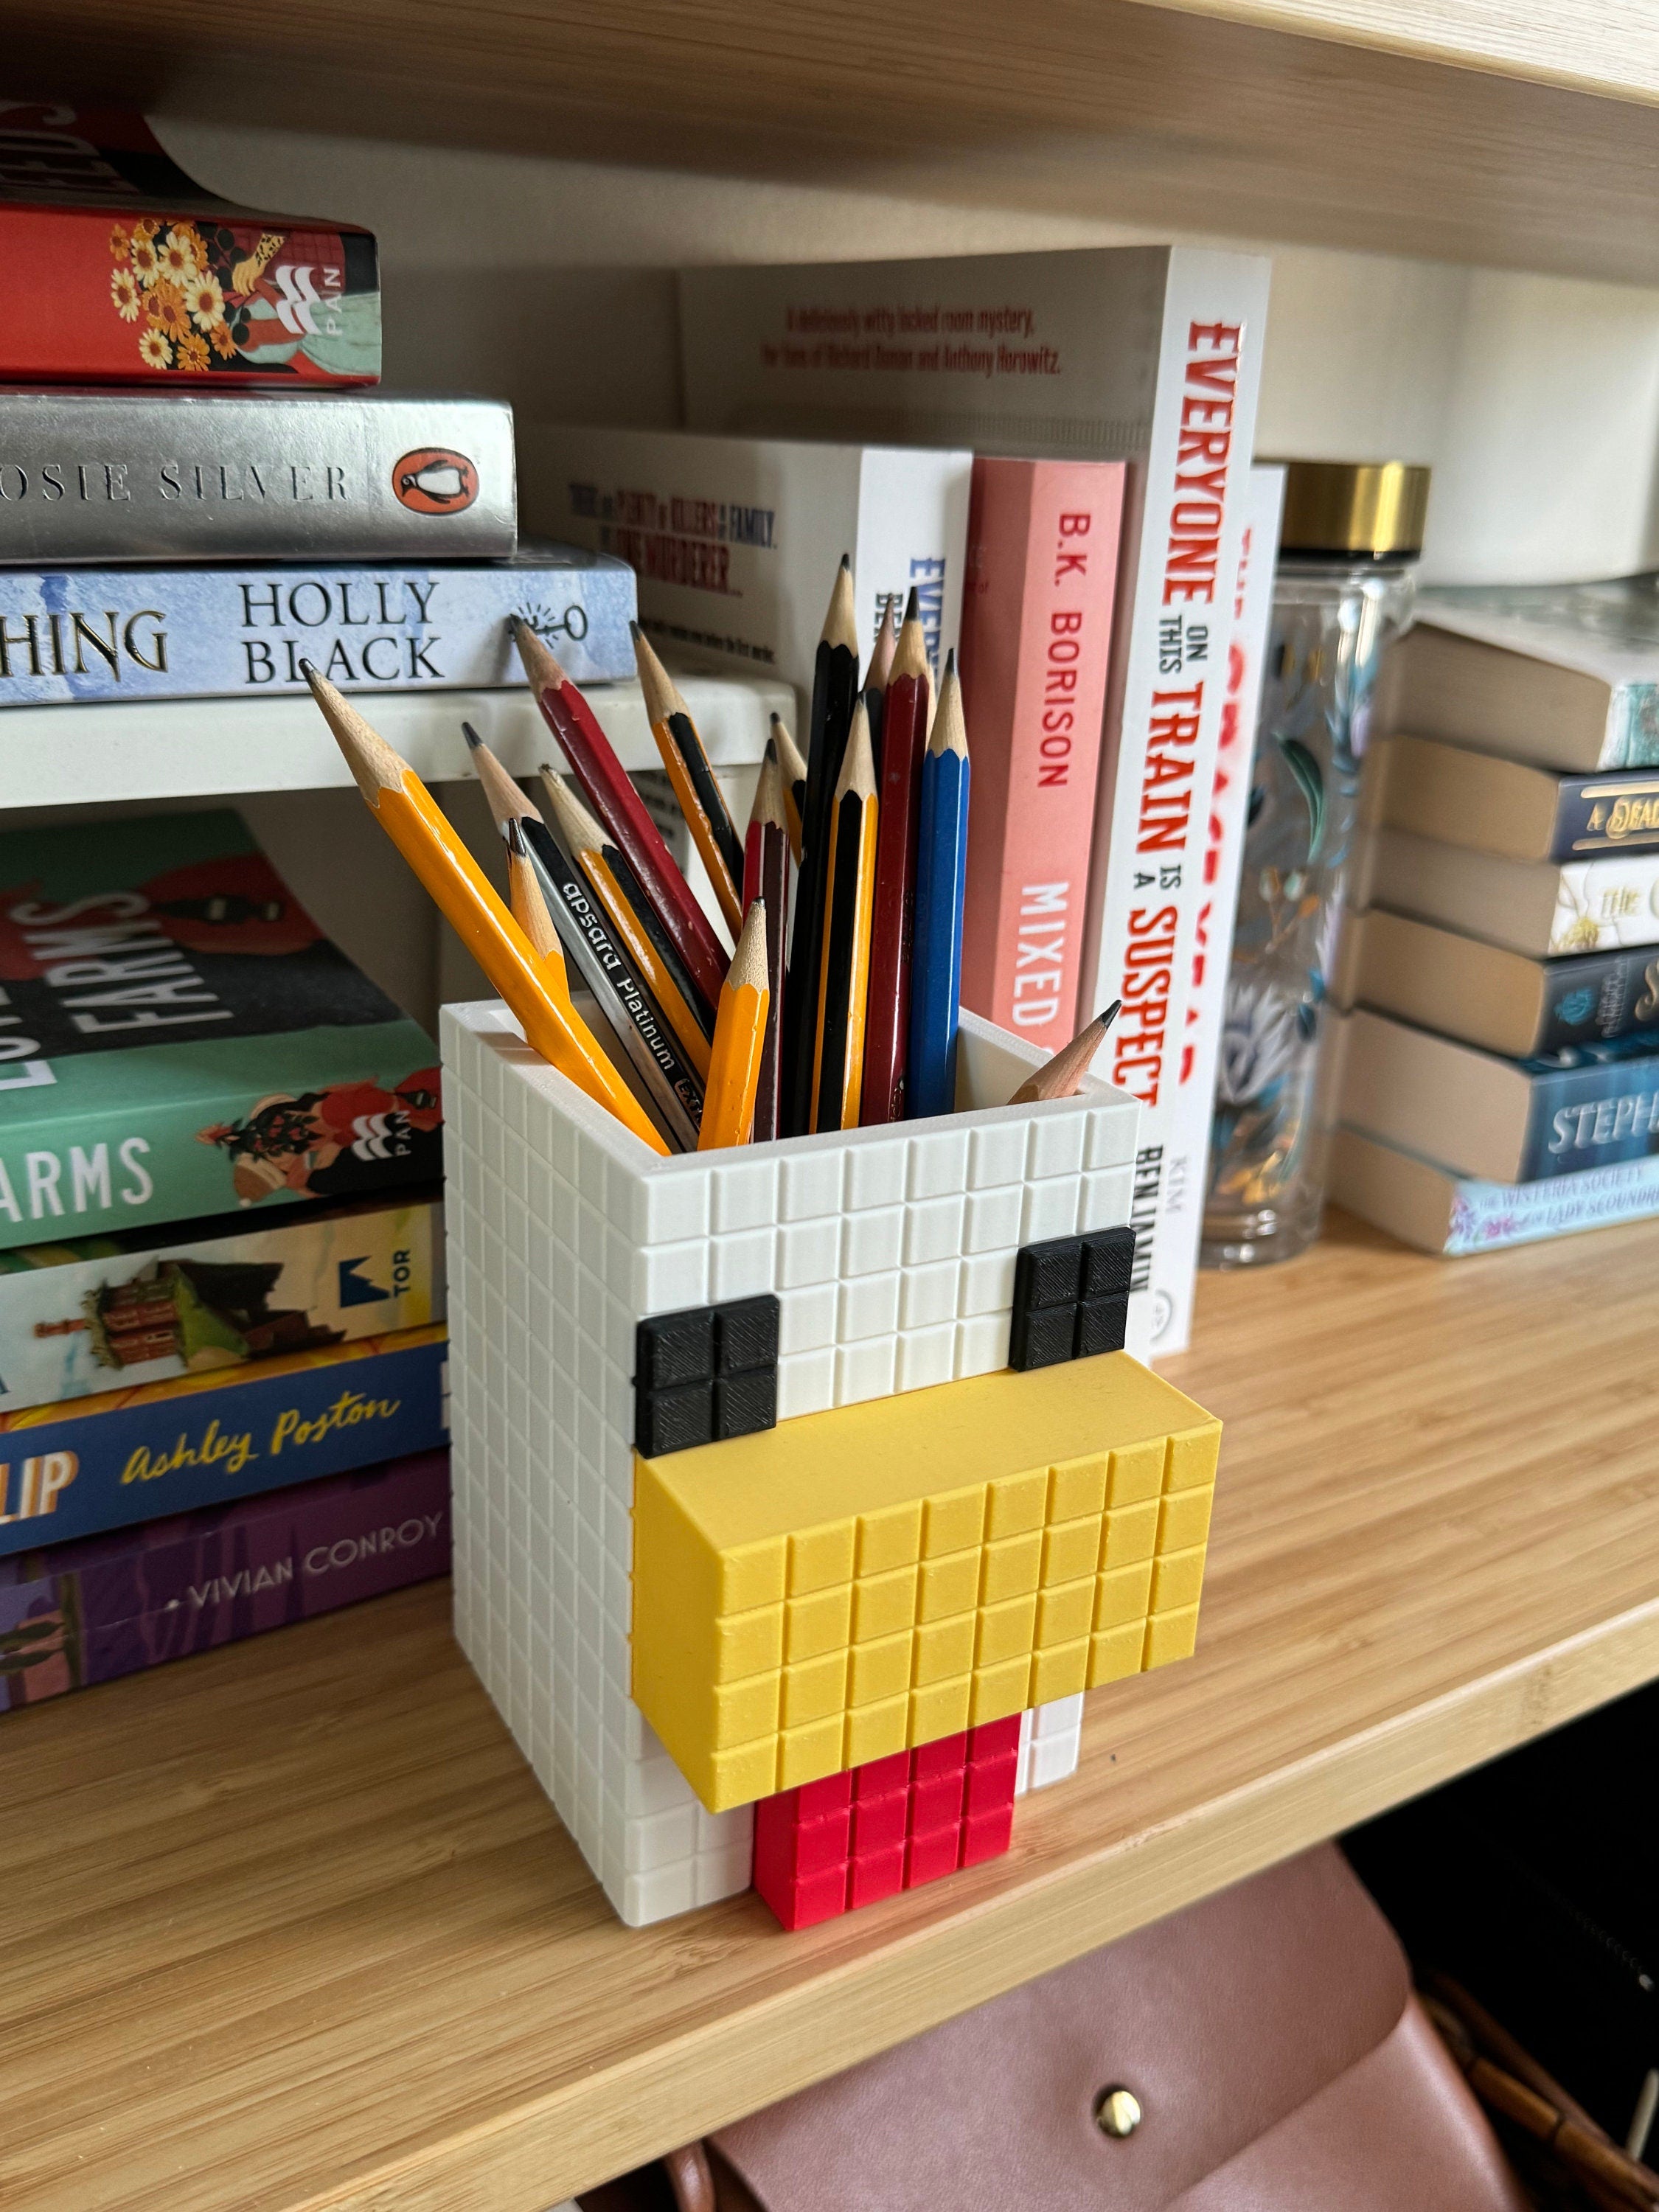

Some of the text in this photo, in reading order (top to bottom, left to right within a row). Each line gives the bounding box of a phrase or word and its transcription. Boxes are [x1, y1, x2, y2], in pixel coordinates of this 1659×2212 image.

[327, 268, 341, 335] PAN
[159, 463, 351, 502] SILVER
[1162, 320, 1245, 606] EVERYONE
[237, 581, 441, 627] HOLLY
[0, 610, 168, 683] HING
[240, 636, 445, 684] BLACK
[1037, 513, 1091, 788] B.K. BORISON
[1159, 615, 1183, 675] THIS
[1186, 623, 1208, 664] ON
[1136, 680, 1205, 855] TRAIN
[1133, 872, 1156, 889] A
[1160, 864, 1182, 891] IS
[9, 891, 235, 1034] FARMS
[563, 883, 622, 970] apsara
[616, 978, 675, 1071] Platinum
[1012, 882, 1069, 1027] MIXED
[1111, 905, 1180, 1108] SUSPECT
[392, 1110, 411, 1155] PAN
[1130, 1144, 1164, 1293] BENJAMIN
[1165, 1155, 1188, 1214] KIM
[393, 1250, 411, 1298] TOR
[120, 1390, 402, 1484] Ashley Poston
[188, 1510, 443, 1610] VIVIAN CONROY
